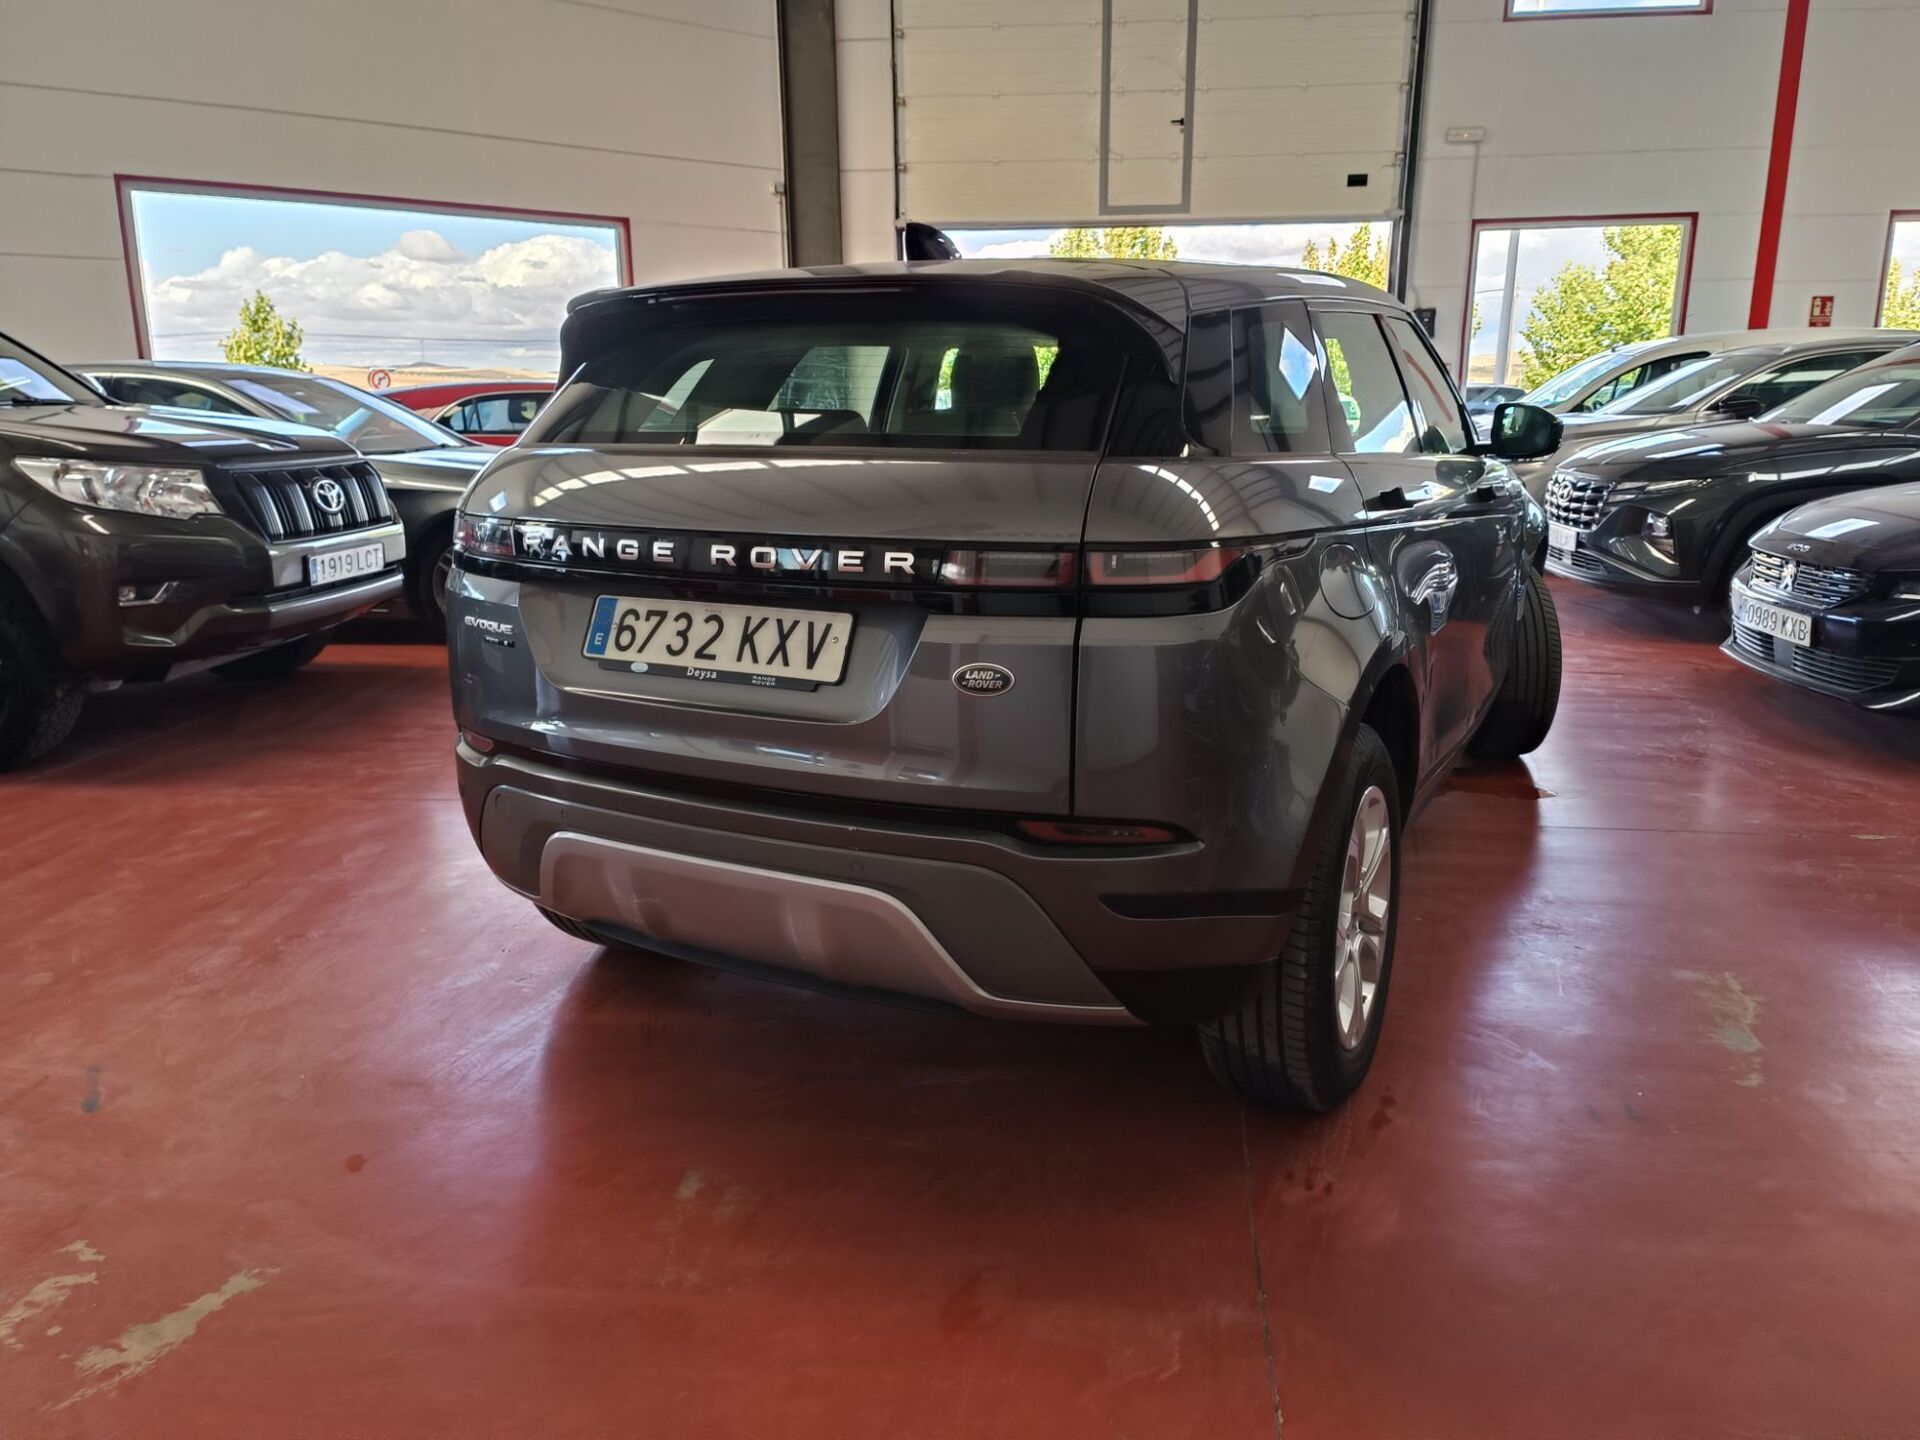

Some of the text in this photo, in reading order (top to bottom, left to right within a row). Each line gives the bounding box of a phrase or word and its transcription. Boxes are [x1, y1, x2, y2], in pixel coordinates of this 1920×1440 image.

[321, 548, 379, 576] 1919 LCT
[523, 530, 915, 574] RANGE ROVER
[464, 615, 513, 635] EVOQUE
[1747, 604, 1808, 641] 0989 KXB
[594, 632, 604, 645] E
[614, 608, 833, 670] 6732 KXV
[687, 667, 718, 680] Deysa
[751, 679, 776, 687] ROVER
